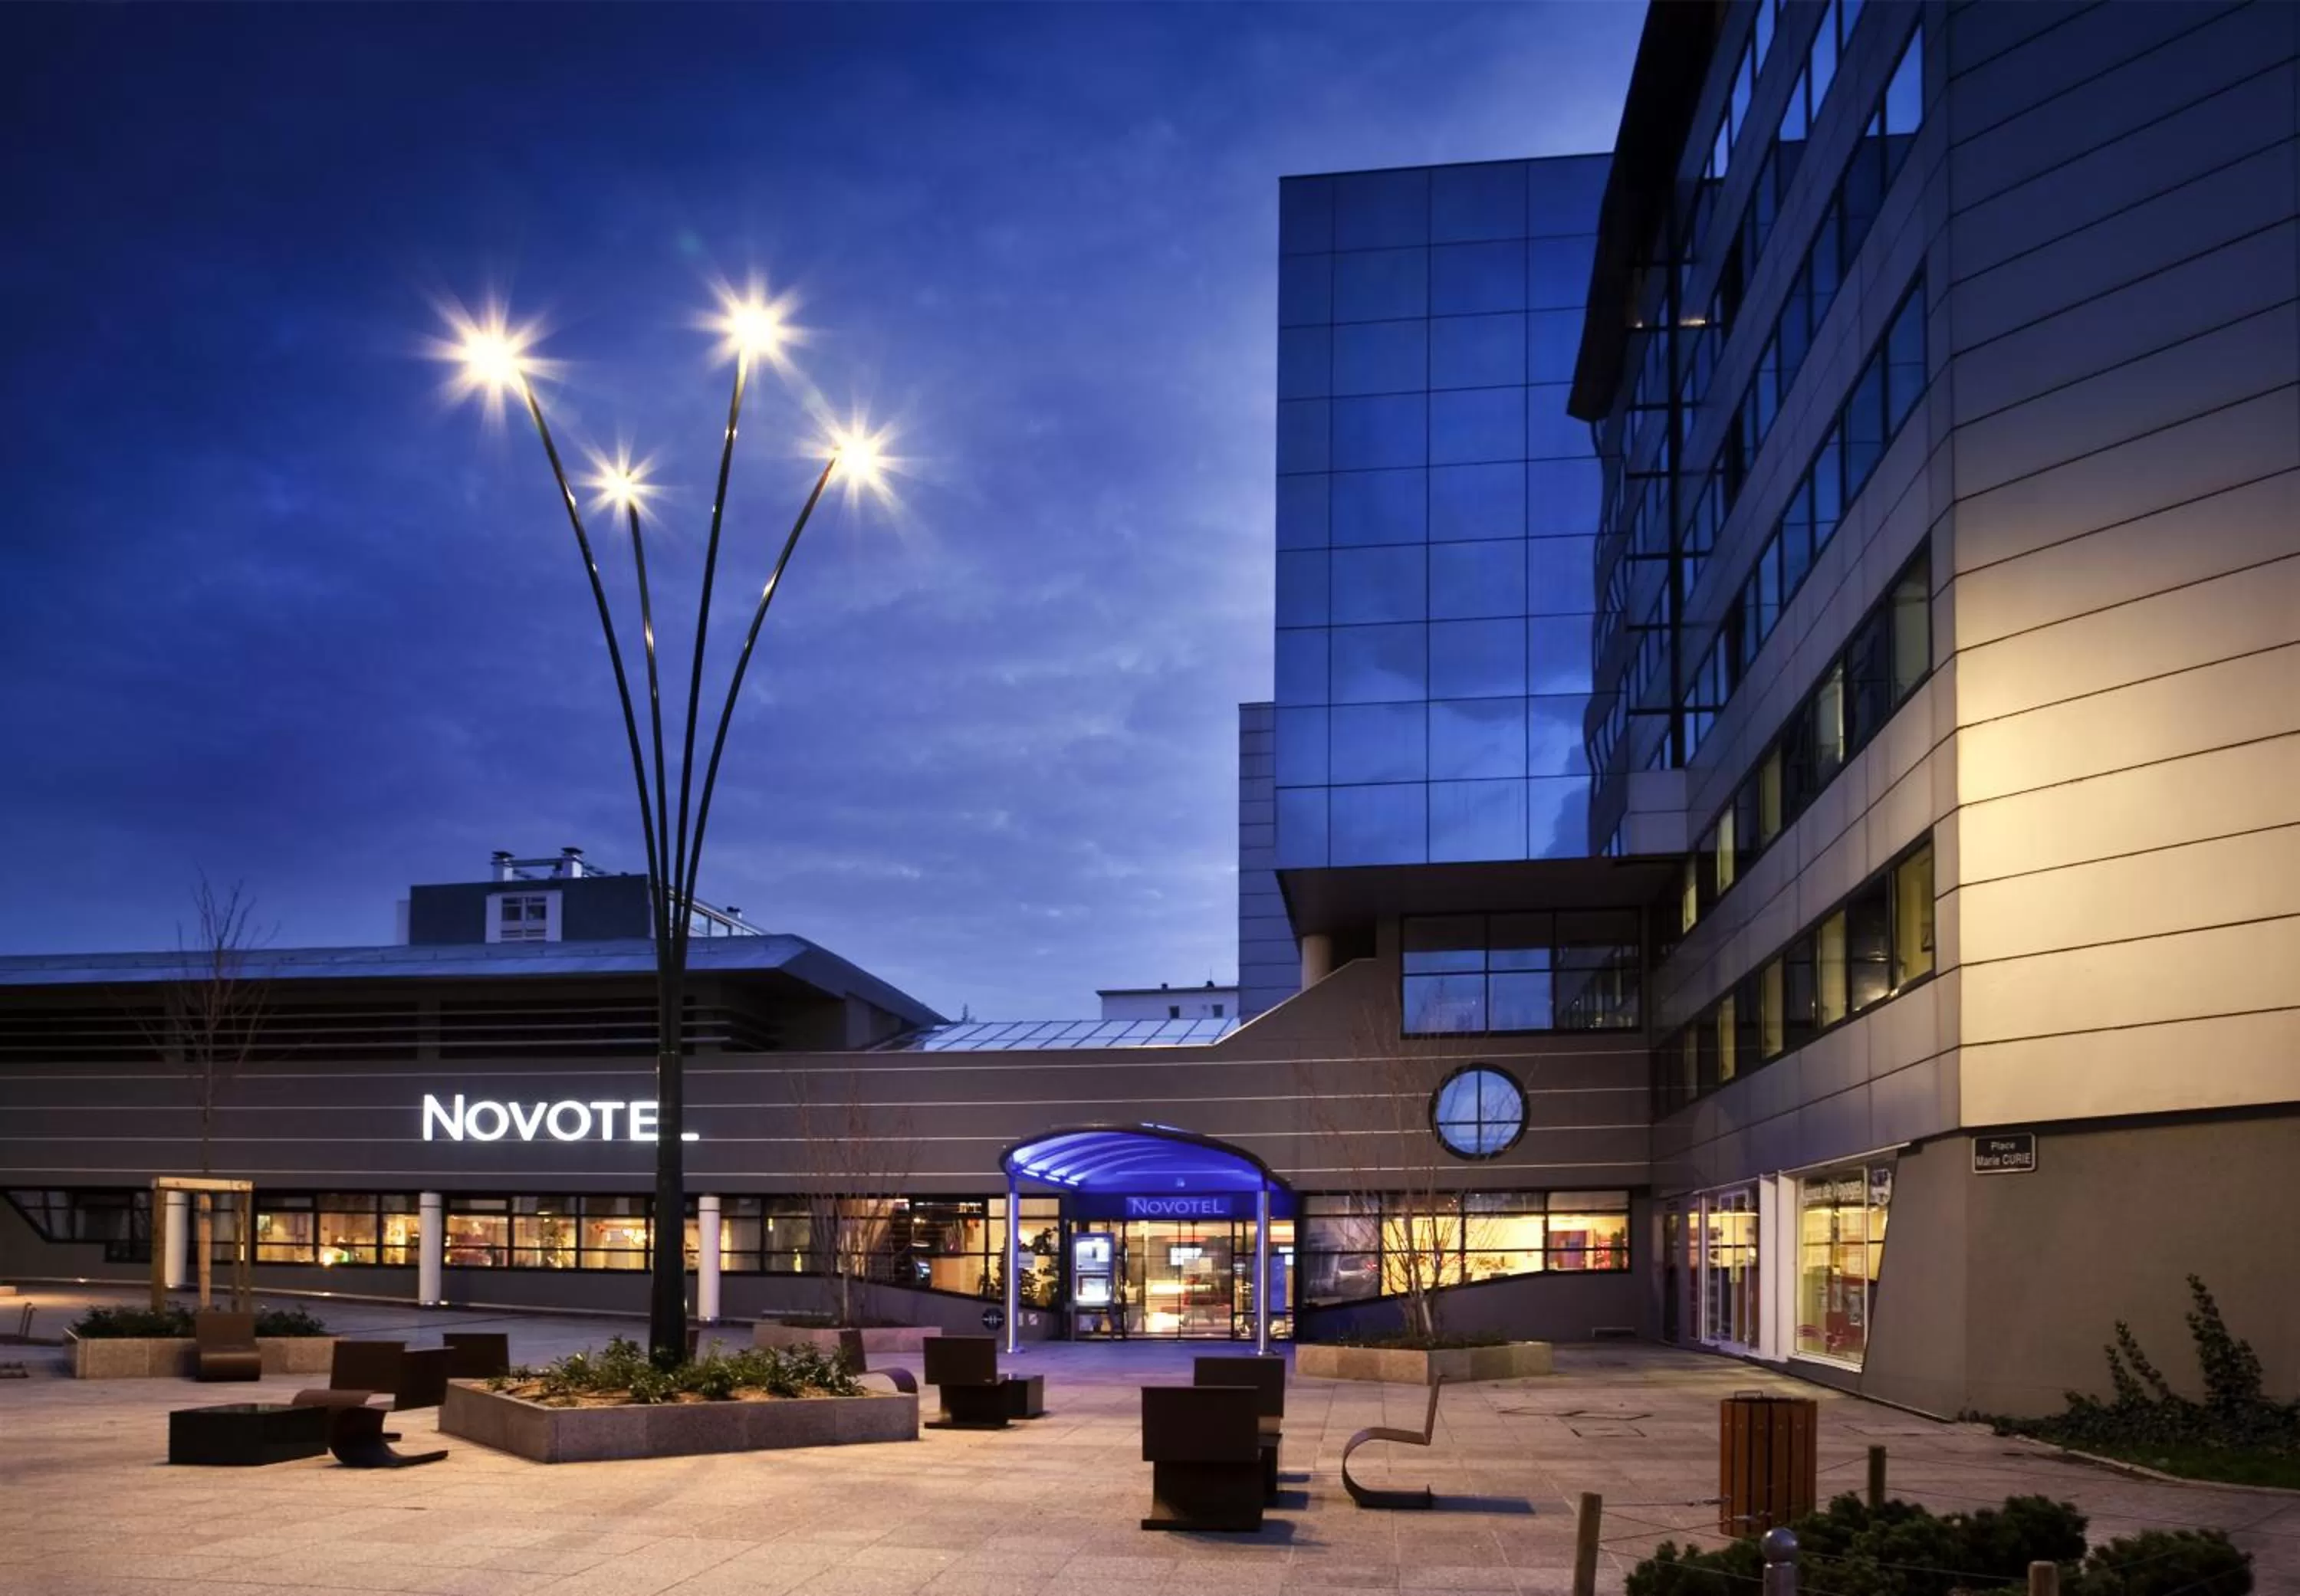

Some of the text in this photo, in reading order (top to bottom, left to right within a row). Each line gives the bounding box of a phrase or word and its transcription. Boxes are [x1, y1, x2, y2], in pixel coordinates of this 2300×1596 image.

[1990, 1141, 2016, 1151] Place
[1976, 1152, 2031, 1166] Marie CURIE
[1131, 1197, 1225, 1214] NOVOTEL
